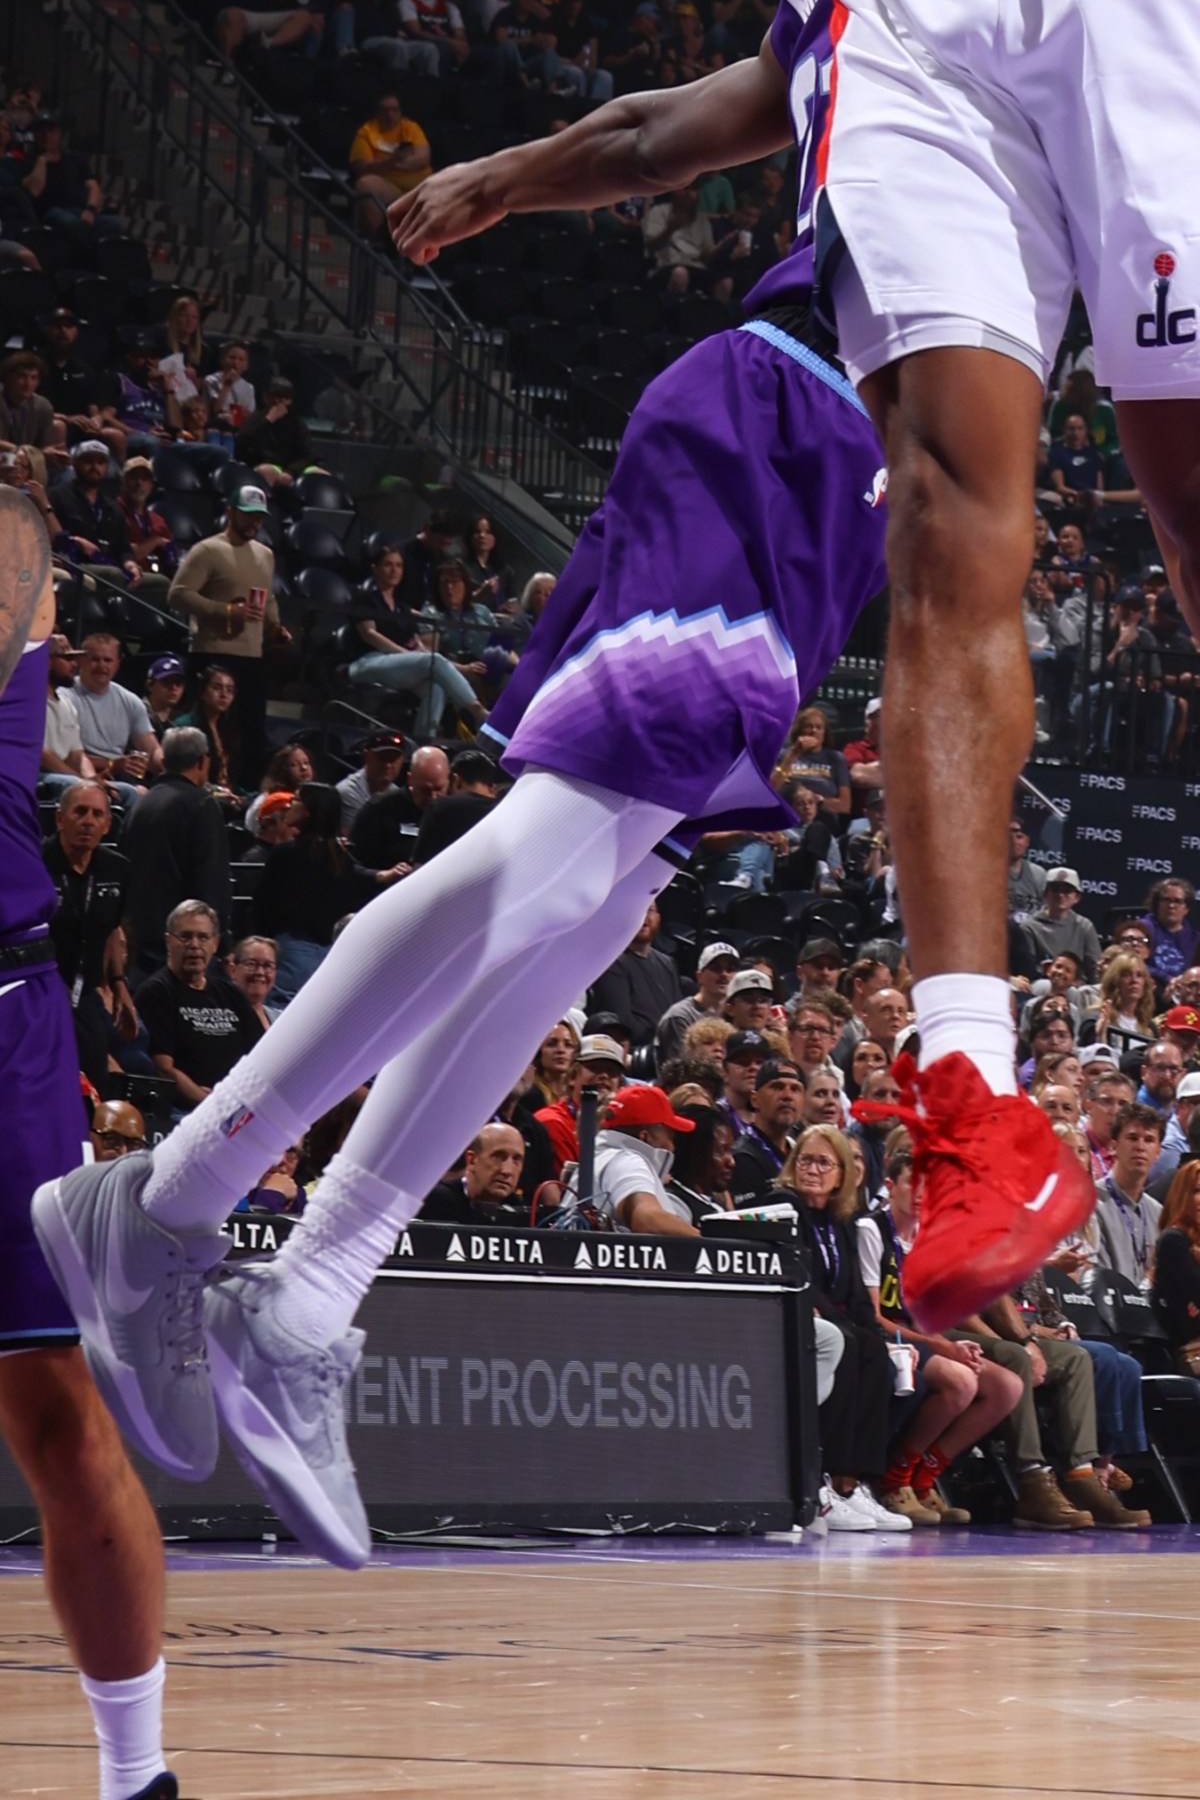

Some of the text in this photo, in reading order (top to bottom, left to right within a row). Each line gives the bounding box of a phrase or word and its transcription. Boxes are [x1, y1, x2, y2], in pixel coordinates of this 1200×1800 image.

[1088, 775, 1126, 791] PACS
[1140, 805, 1176, 821] PACS
[1085, 827, 1123, 843] PACS
[1136, 858, 1172, 874] PACS
[1081, 880, 1118, 895] PACS
[219, 1225, 277, 1249] LTA
[471, 1237, 783, 1276] DELTA DELTA DELTA
[344, 1356, 752, 1429] ENT PROCESSING
